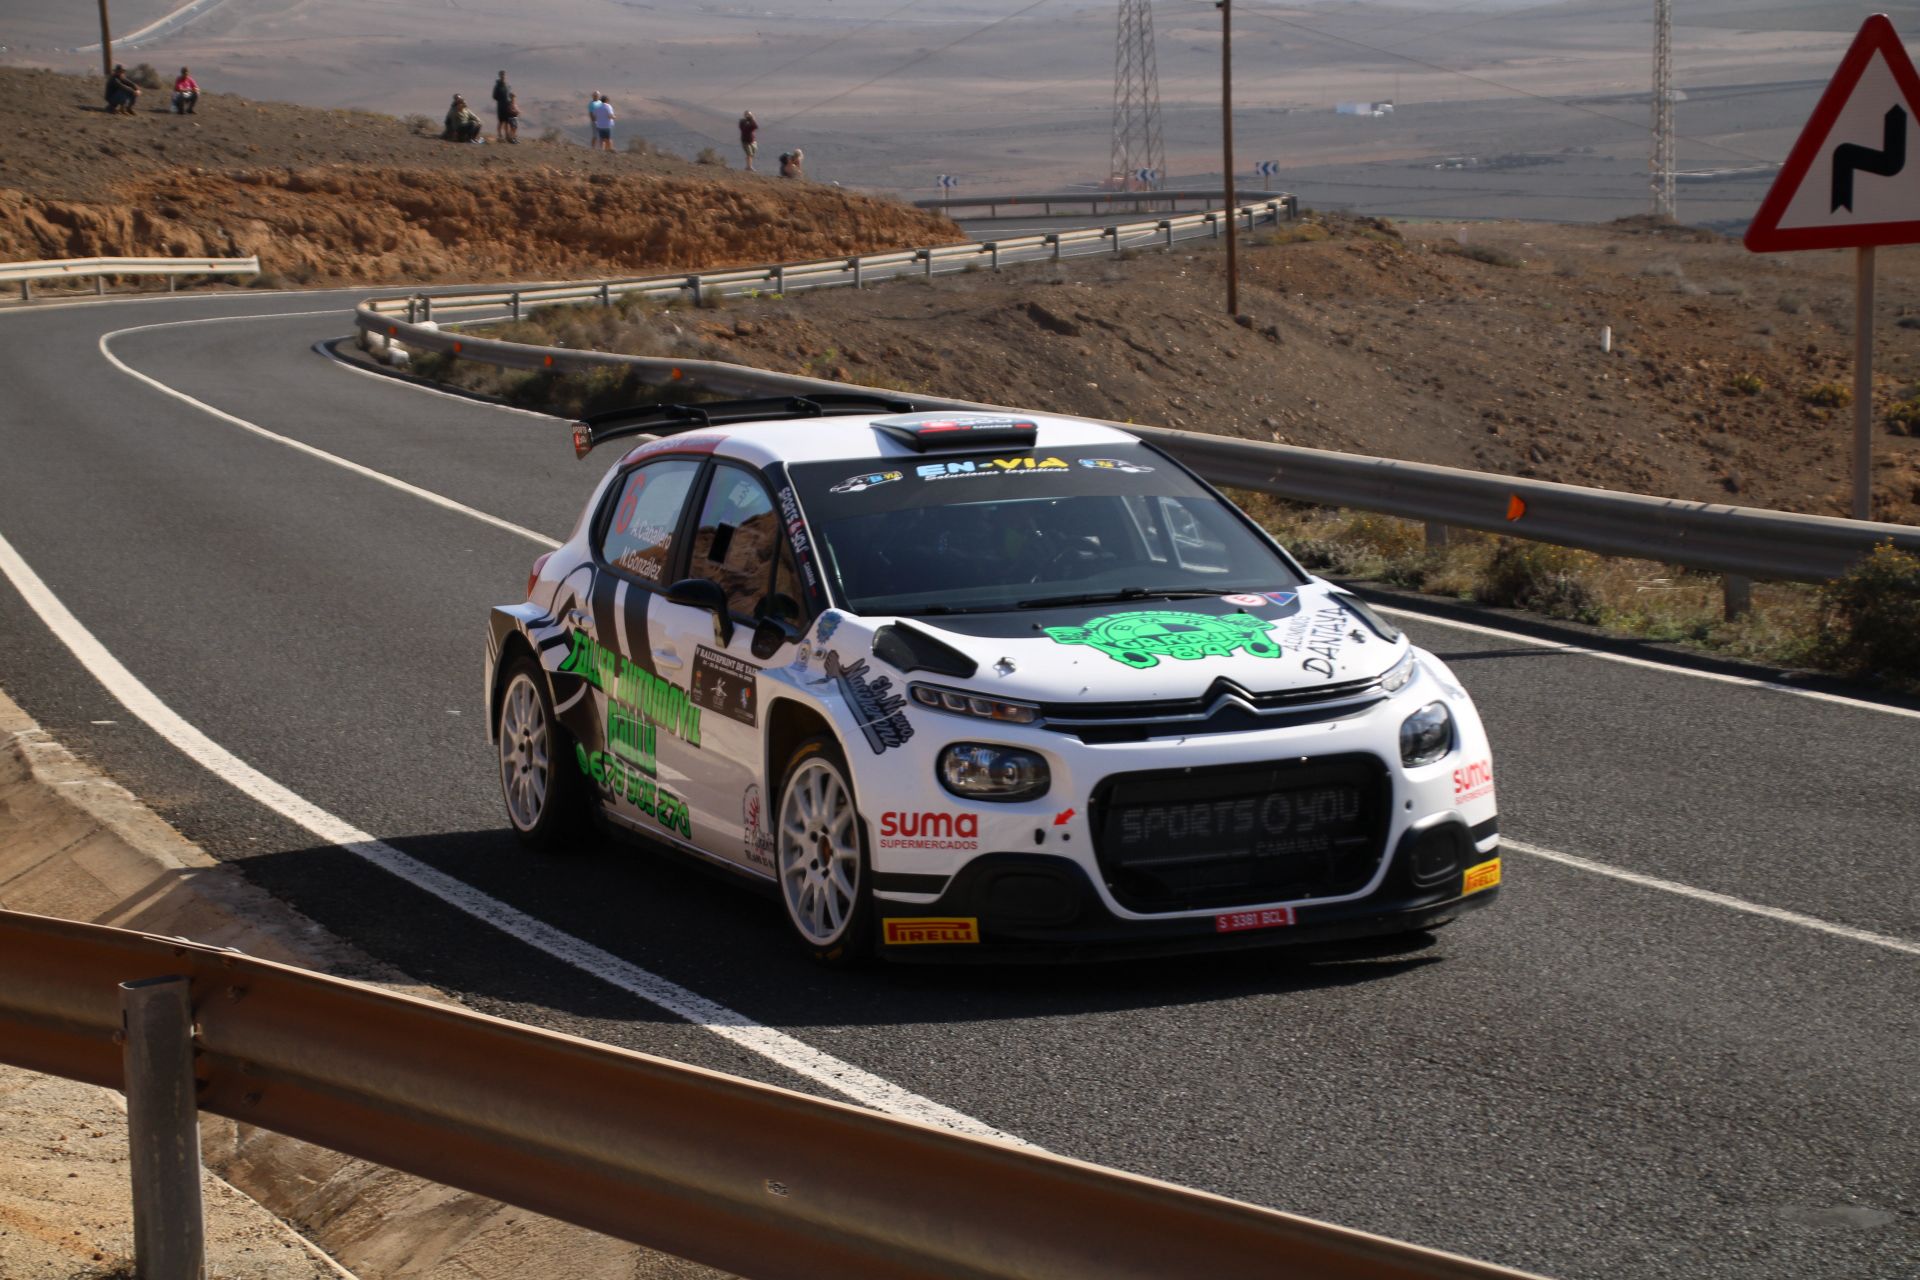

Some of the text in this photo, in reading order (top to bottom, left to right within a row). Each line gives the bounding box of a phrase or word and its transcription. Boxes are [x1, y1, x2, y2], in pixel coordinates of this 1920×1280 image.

[916, 457, 1069, 477] EN-VIA
[924, 470, 1000, 481] Soluciones
[616, 473, 646, 535] 6
[778, 487, 800, 525] SPORTS
[1115, 630, 1250, 650] GARAJE
[1302, 607, 1346, 679] DANTAYA
[557, 627, 616, 698] TALLER
[616, 654, 702, 749] AUTOMOVIL
[869, 674, 893, 701] El
[657, 787, 692, 840] 270
[880, 812, 978, 838] suma
[1121, 800, 1254, 843] SPORTS
[880, 839, 978, 850] SUPERMERCADOS
[887, 921, 972, 942] PIRELLI
